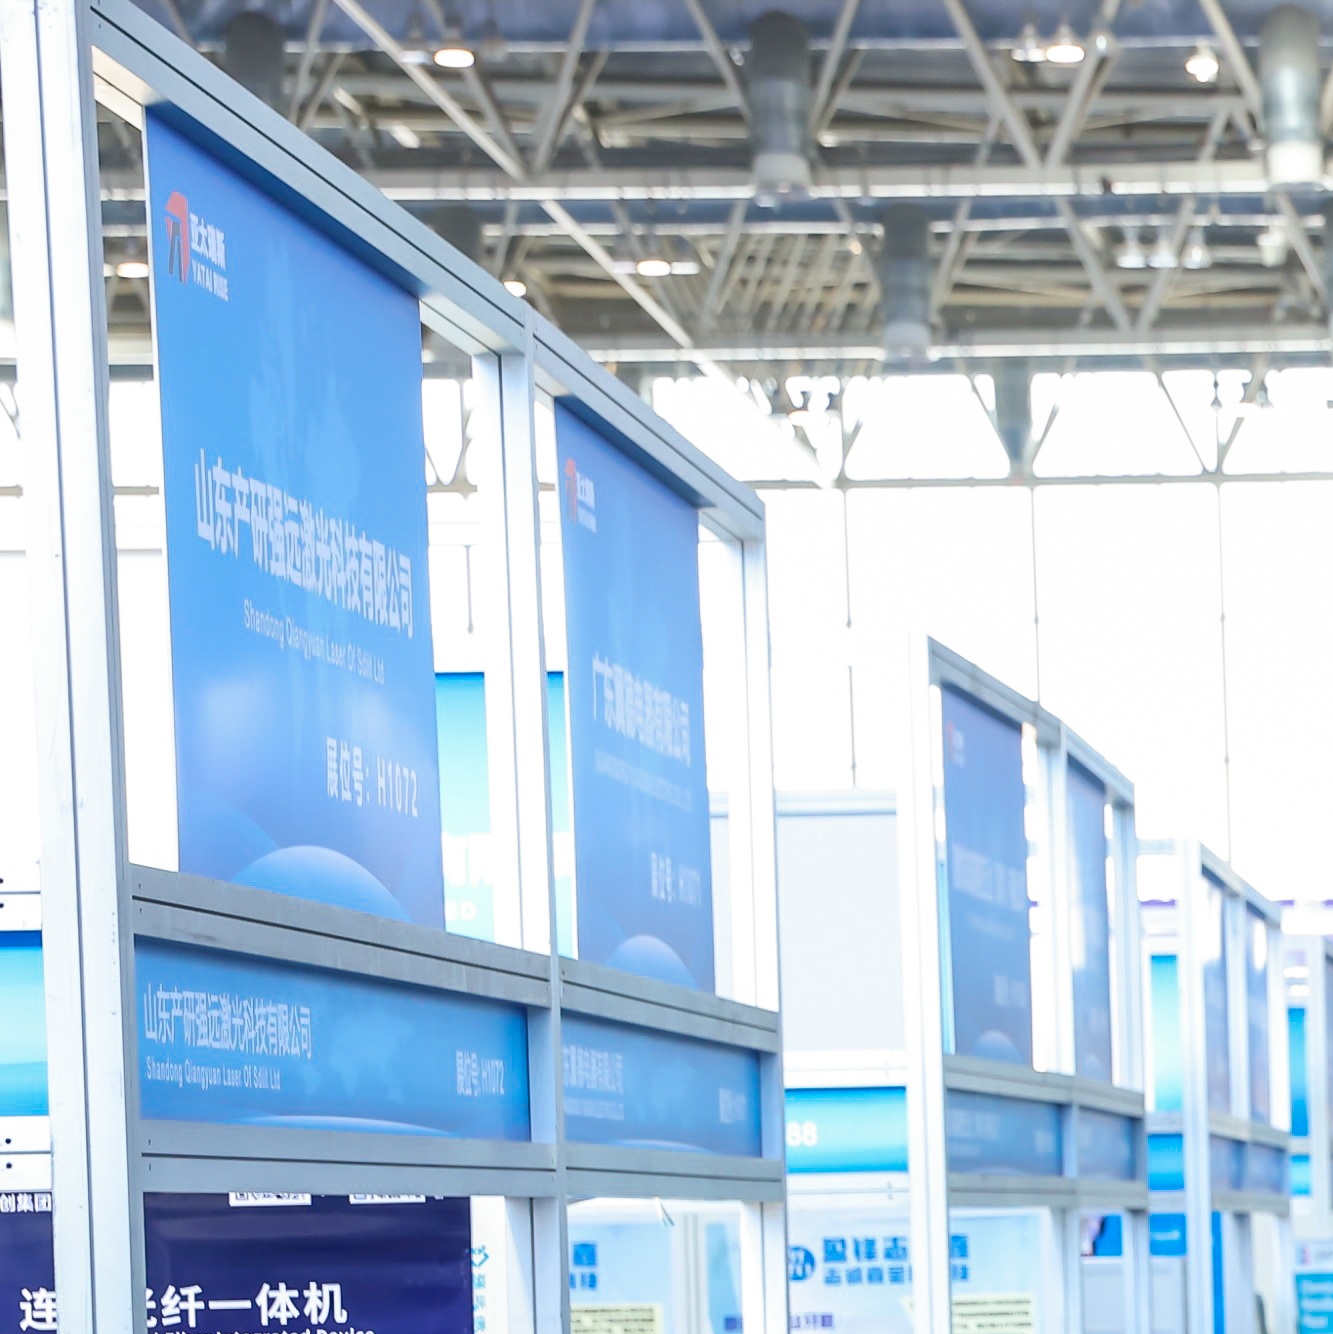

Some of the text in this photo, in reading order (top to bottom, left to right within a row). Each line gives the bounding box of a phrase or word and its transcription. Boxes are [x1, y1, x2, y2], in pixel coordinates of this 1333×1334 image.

[244, 599, 284, 649] Shandong
[146, 1055, 183, 1088] Shandong
[184, 1058, 221, 1090] Qiangyuan
